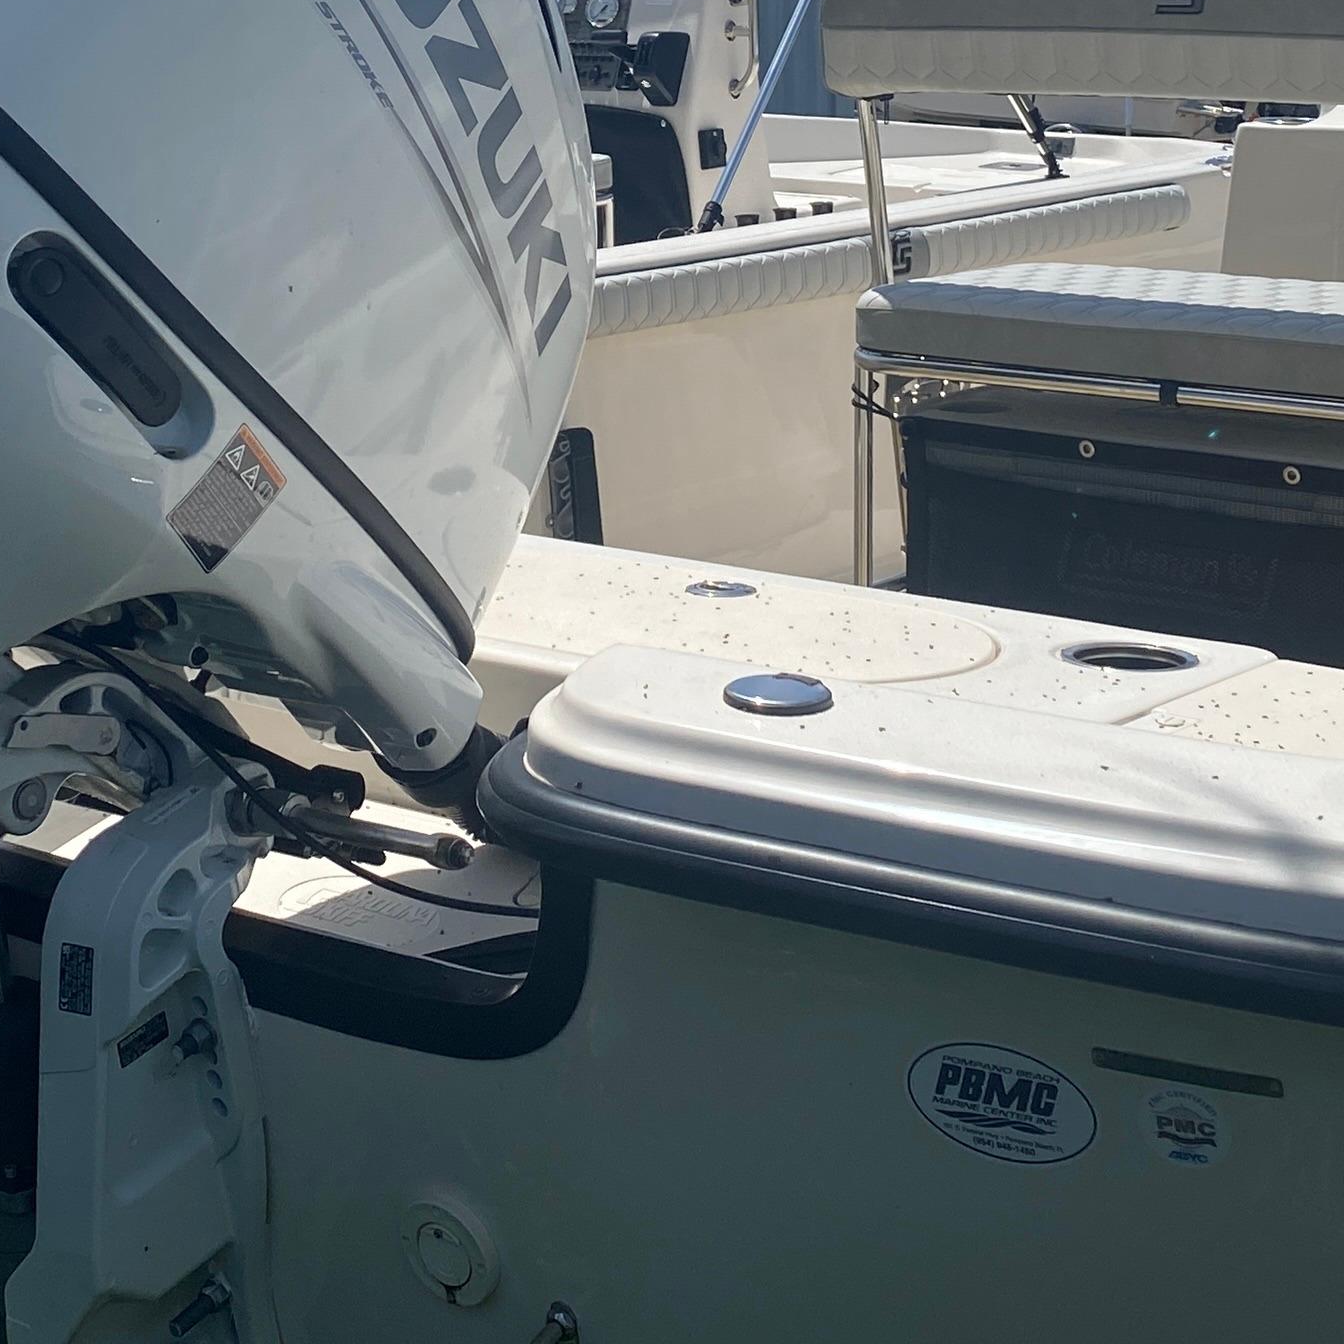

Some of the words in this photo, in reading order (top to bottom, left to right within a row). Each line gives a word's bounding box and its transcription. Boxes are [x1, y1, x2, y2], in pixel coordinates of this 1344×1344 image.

[941, 1054, 1014, 1075] POMPANO
[1015, 1069, 1061, 1085] BEACH
[934, 1062, 1059, 1118] PBMC
[931, 1095, 979, 1113] MARINE
[982, 1106, 1034, 1123] CENTER
[1034, 1117, 1060, 1128] INC
[1155, 1114, 1217, 1138] PMC
